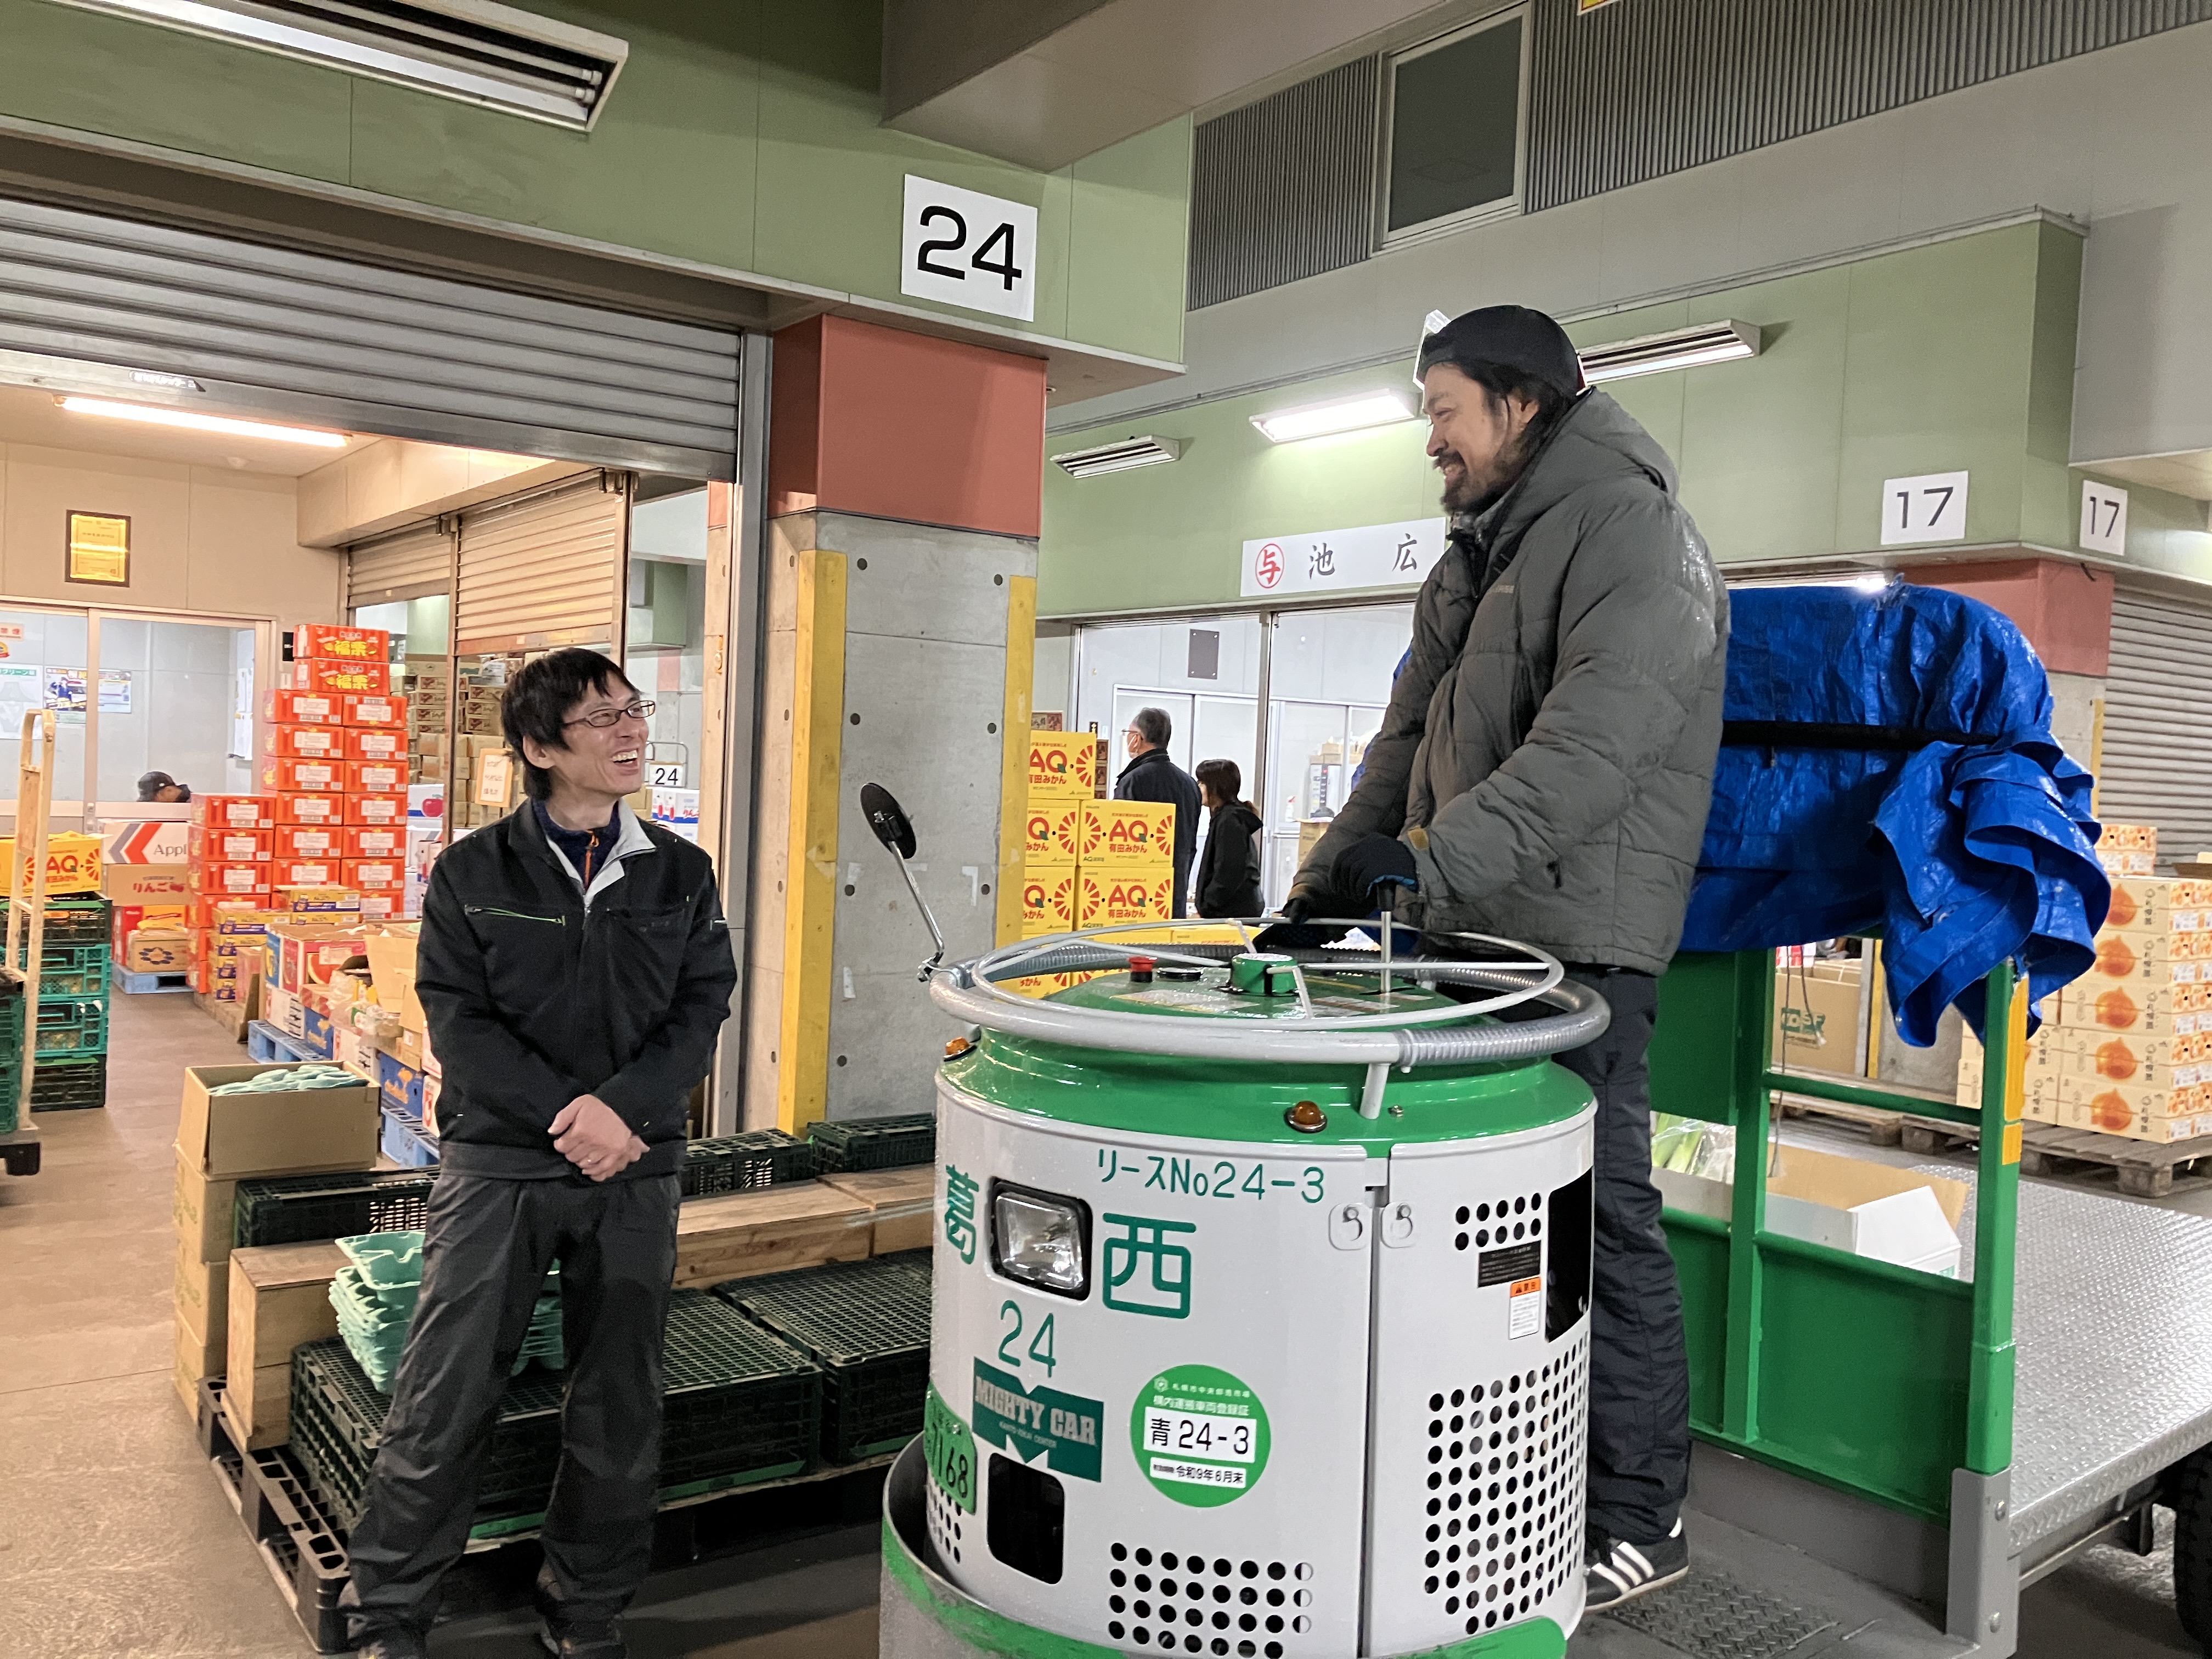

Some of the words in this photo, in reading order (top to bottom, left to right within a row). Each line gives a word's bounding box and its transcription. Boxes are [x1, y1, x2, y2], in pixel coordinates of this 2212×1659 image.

[917, 205, 1022, 291] 24
[1897, 486, 1954, 529] 17
[2089, 496, 2120, 538] 17
[1030, 748, 1067, 773] AQ
[655, 768, 678, 785] 24
[1109, 819, 1148, 843] AQ
[1109, 843, 1147, 853] 有田みかん
[47, 855, 78, 874] AQ
[133, 882, 167, 893] りんご
[1108, 884, 1147, 907] AQ
[1102, 1212, 1198, 1319] 西
[998, 1300, 1057, 1378] 24
[975, 1376, 1045, 1430] MIGHTY
[1050, 1409, 1097, 1446] CAR
[1150, 1418, 1171, 1446] 青
[1178, 1419, 1249, 1454] 24-3
